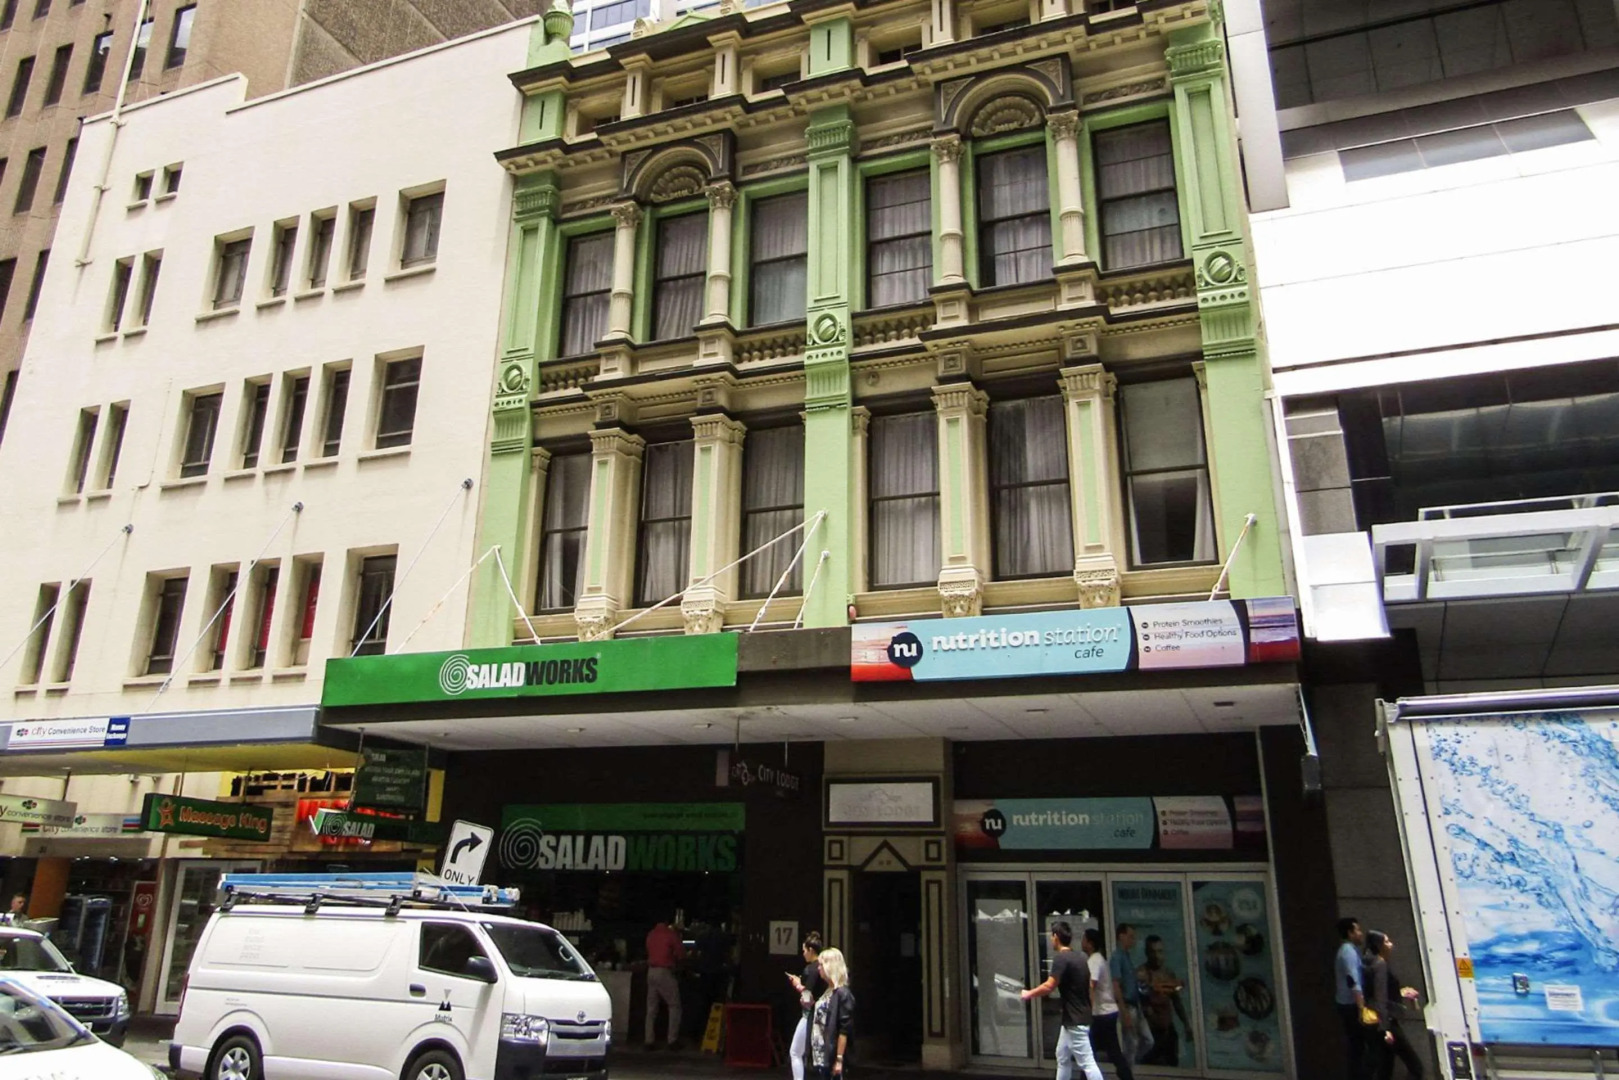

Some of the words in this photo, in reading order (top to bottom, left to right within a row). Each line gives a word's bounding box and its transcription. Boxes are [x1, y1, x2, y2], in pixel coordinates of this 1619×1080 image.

[1153, 620, 1180, 628] Protein
[1182, 617, 1223, 627] Smoothies
[931, 627, 1041, 652] nutrition
[1044, 622, 1119, 646] station
[1154, 630, 1182, 640] Healthy
[1185, 630, 1204, 638] Food
[1206, 628, 1237, 638] Options
[1074, 645, 1105, 659] cafe
[1155, 644, 1180, 652] Coffee
[48, 727, 88, 736] Convenience
[88, 725, 106, 734] Store
[6, 810, 52, 820] convenience
[179, 806, 237, 830] Massage
[239, 812, 268, 834] King
[1012, 810, 1090, 826] nutrition
[1113, 827, 1136, 838] cafe
[444, 868, 475, 886] ONLY
[774, 927, 794, 946] 17
